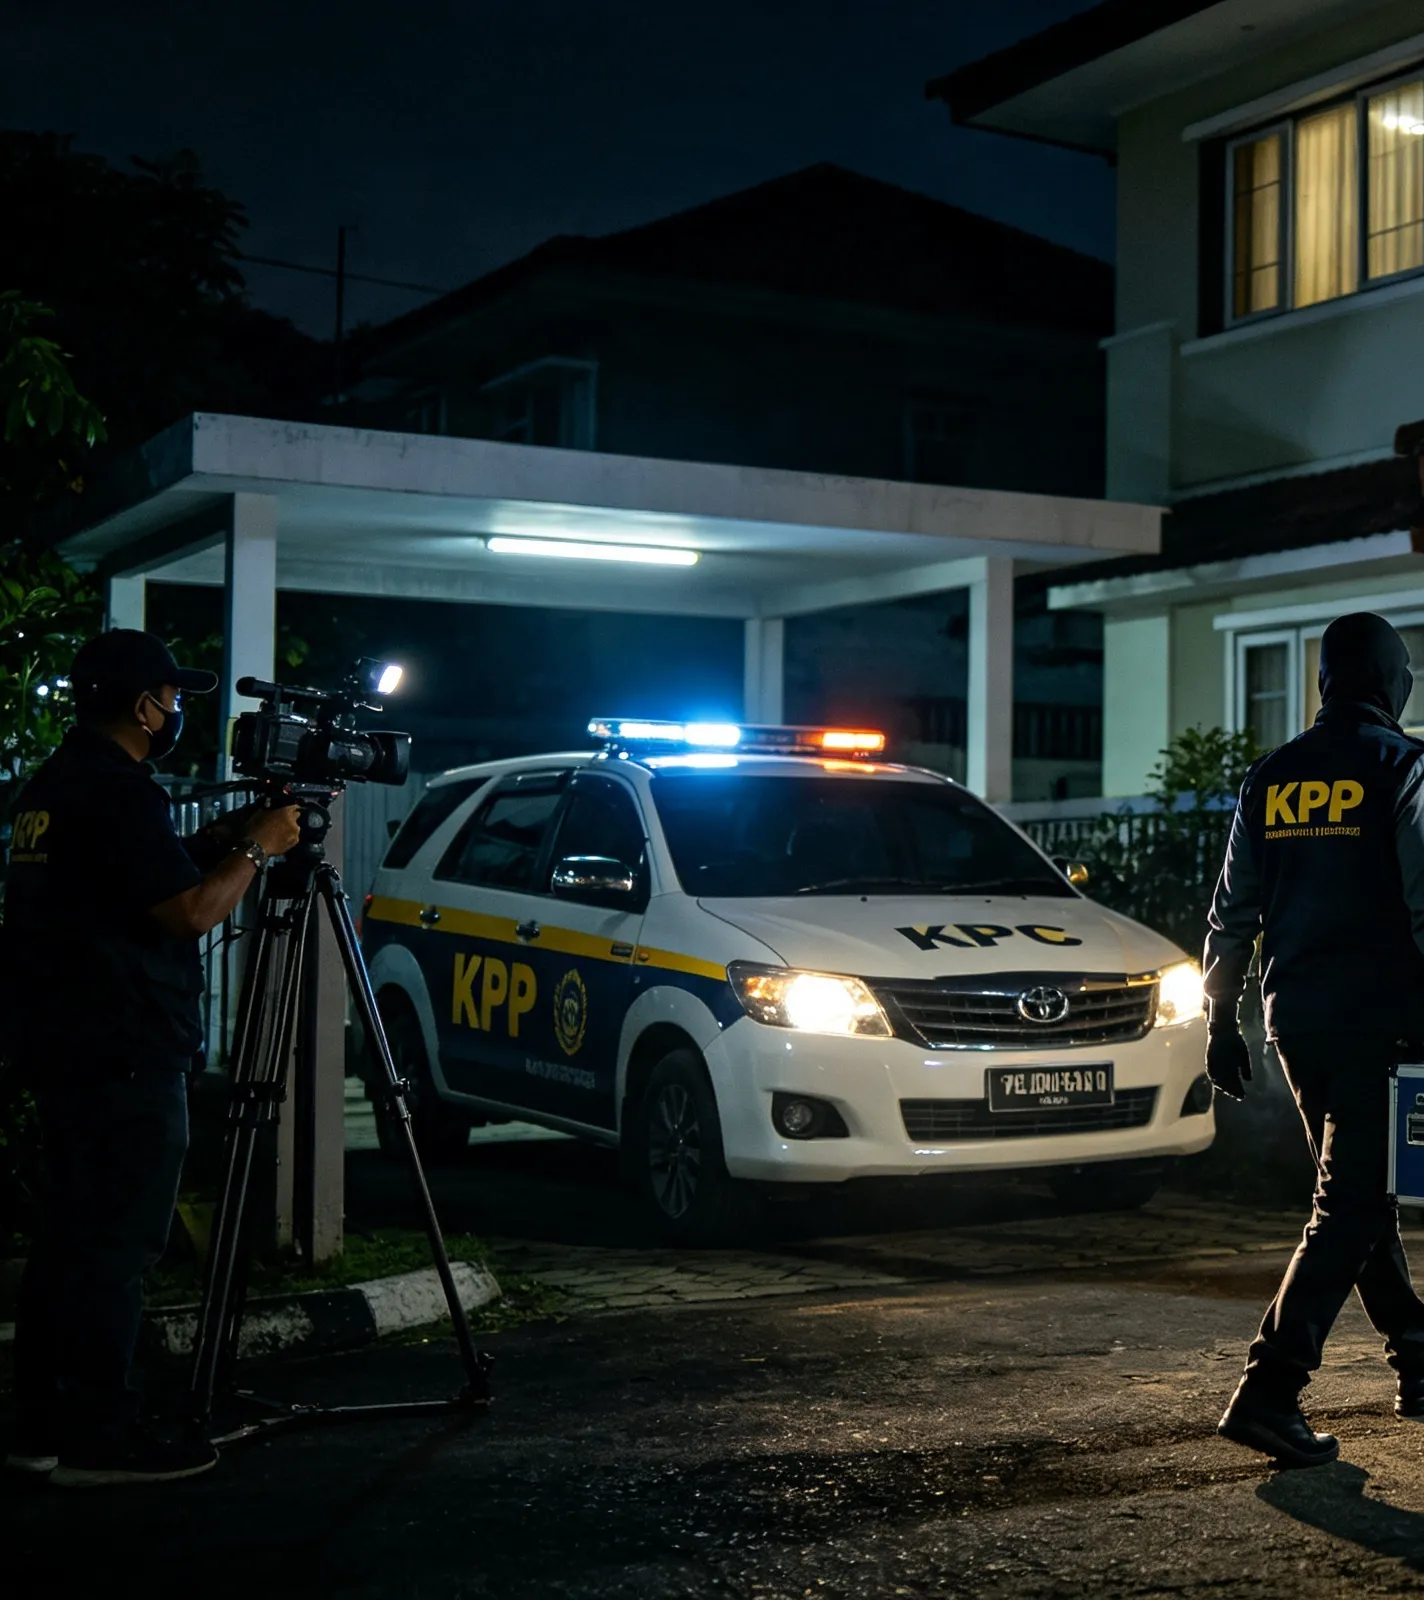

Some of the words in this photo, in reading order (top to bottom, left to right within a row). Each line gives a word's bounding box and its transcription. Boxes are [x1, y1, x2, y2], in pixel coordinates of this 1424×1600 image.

[1265, 779, 1365, 827] KPP
[894, 923, 1083, 951] KPC
[452, 952, 538, 1038] KPP
